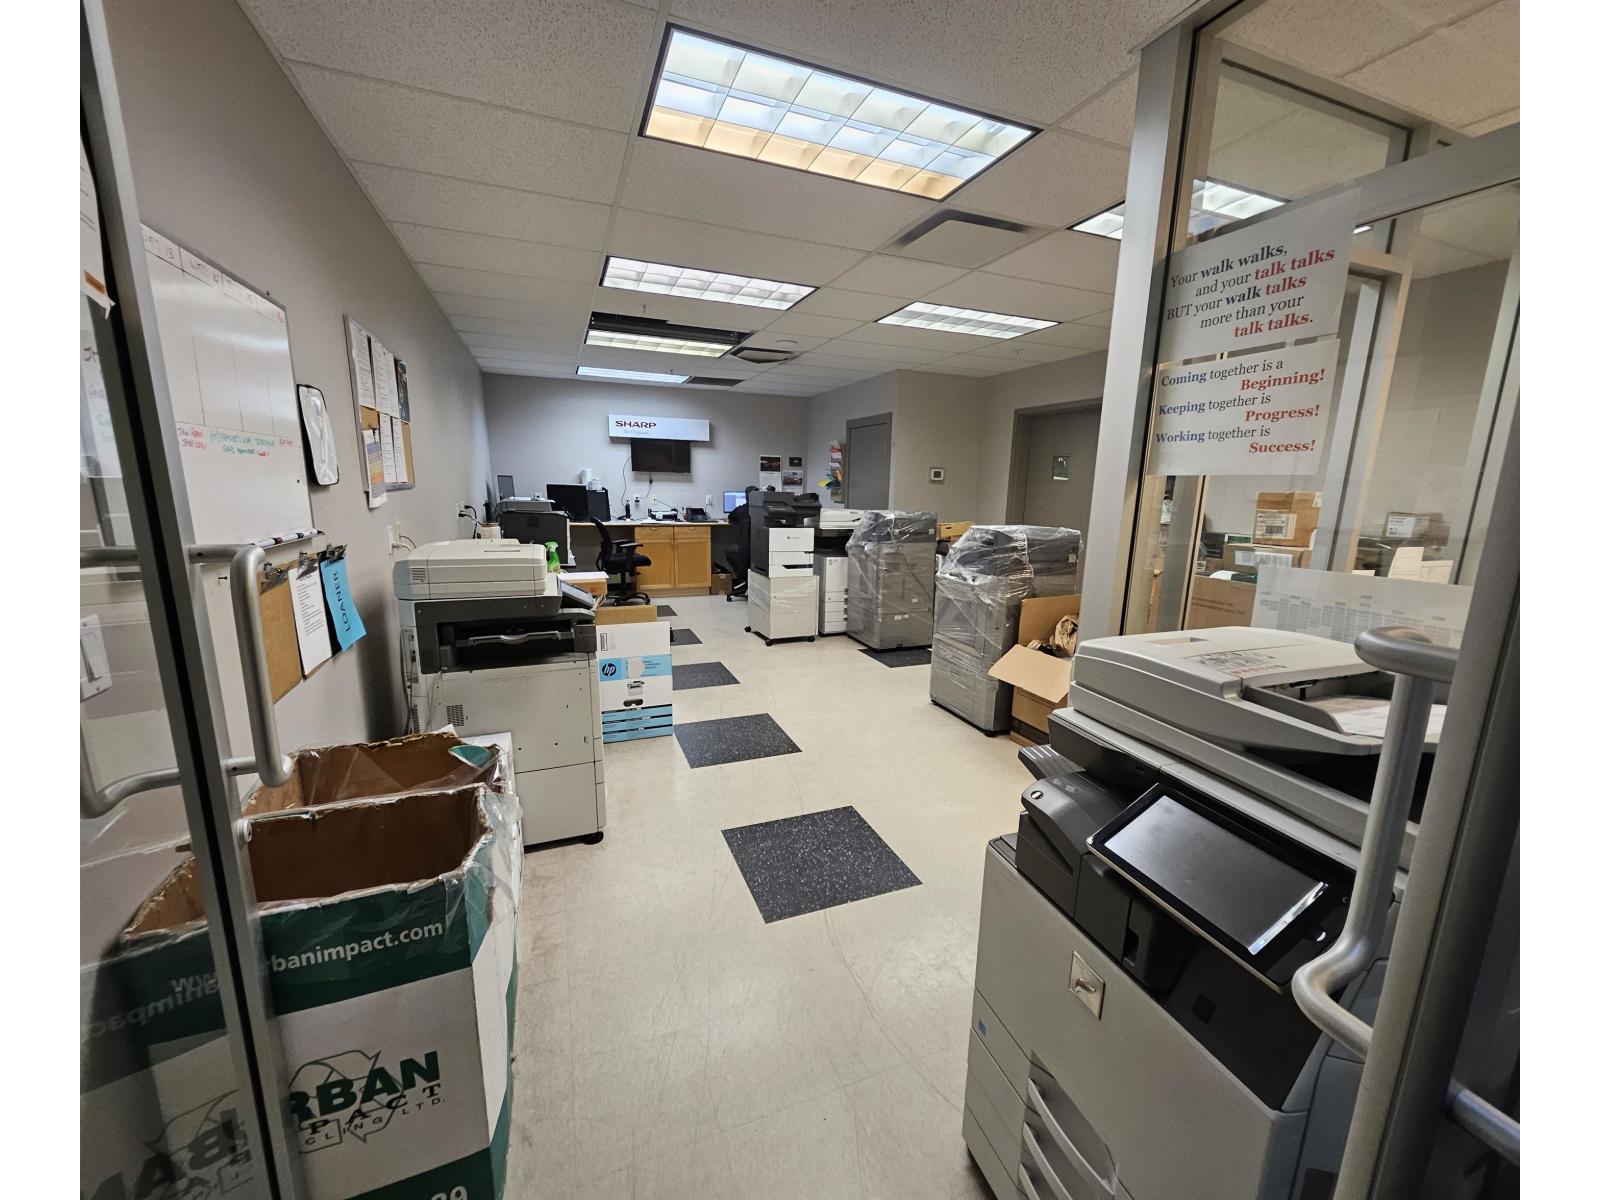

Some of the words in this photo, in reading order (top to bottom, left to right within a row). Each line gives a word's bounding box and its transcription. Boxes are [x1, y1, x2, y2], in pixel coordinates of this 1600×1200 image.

[1170, 271, 1198, 288] Your
[1200, 258, 1234, 279] walk
[1195, 280, 1218, 297] and
[1220, 273, 1252, 293] your
[1254, 260, 1286, 281] talk
[1291, 248, 1335, 270] talks
[1167, 304, 1193, 320] BUT
[1193, 298, 1223, 317] your
[1225, 286, 1262, 306] walk
[1265, 275, 1307, 295] talks
[1200, 313, 1233, 329] more
[1235, 305, 1265, 321] than
[1268, 296, 1304, 316] your
[1233, 321, 1264, 337] talk
[1267, 312, 1313, 331] talks.
[1161, 371, 1207, 387] Coming
[1209, 362, 1259, 381] together
[1261, 359, 1273, 372] is
[1275, 360, 1283, 370] a
[1240, 368, 1325, 391] Beginning!
[1158, 401, 1206, 416] Keeping
[1208, 394, 1258, 411] together
[1260, 393, 1272, 404] is
[1244, 404, 1320, 423] Progress!
[615, 420, 657, 429] SHARP
[1155, 430, 1206, 444] Working
[1207, 425, 1257, 442] together
[1259, 425, 1271, 437] is
[1248, 439, 1316, 453] Success!
[333, 571, 351, 632] LOANER
[603, 663, 616, 677] hp
[268, 922, 443, 973] banimpact.com
[289, 1050, 440, 1121] RBAN
[309, 1083, 441, 1136] PACT
